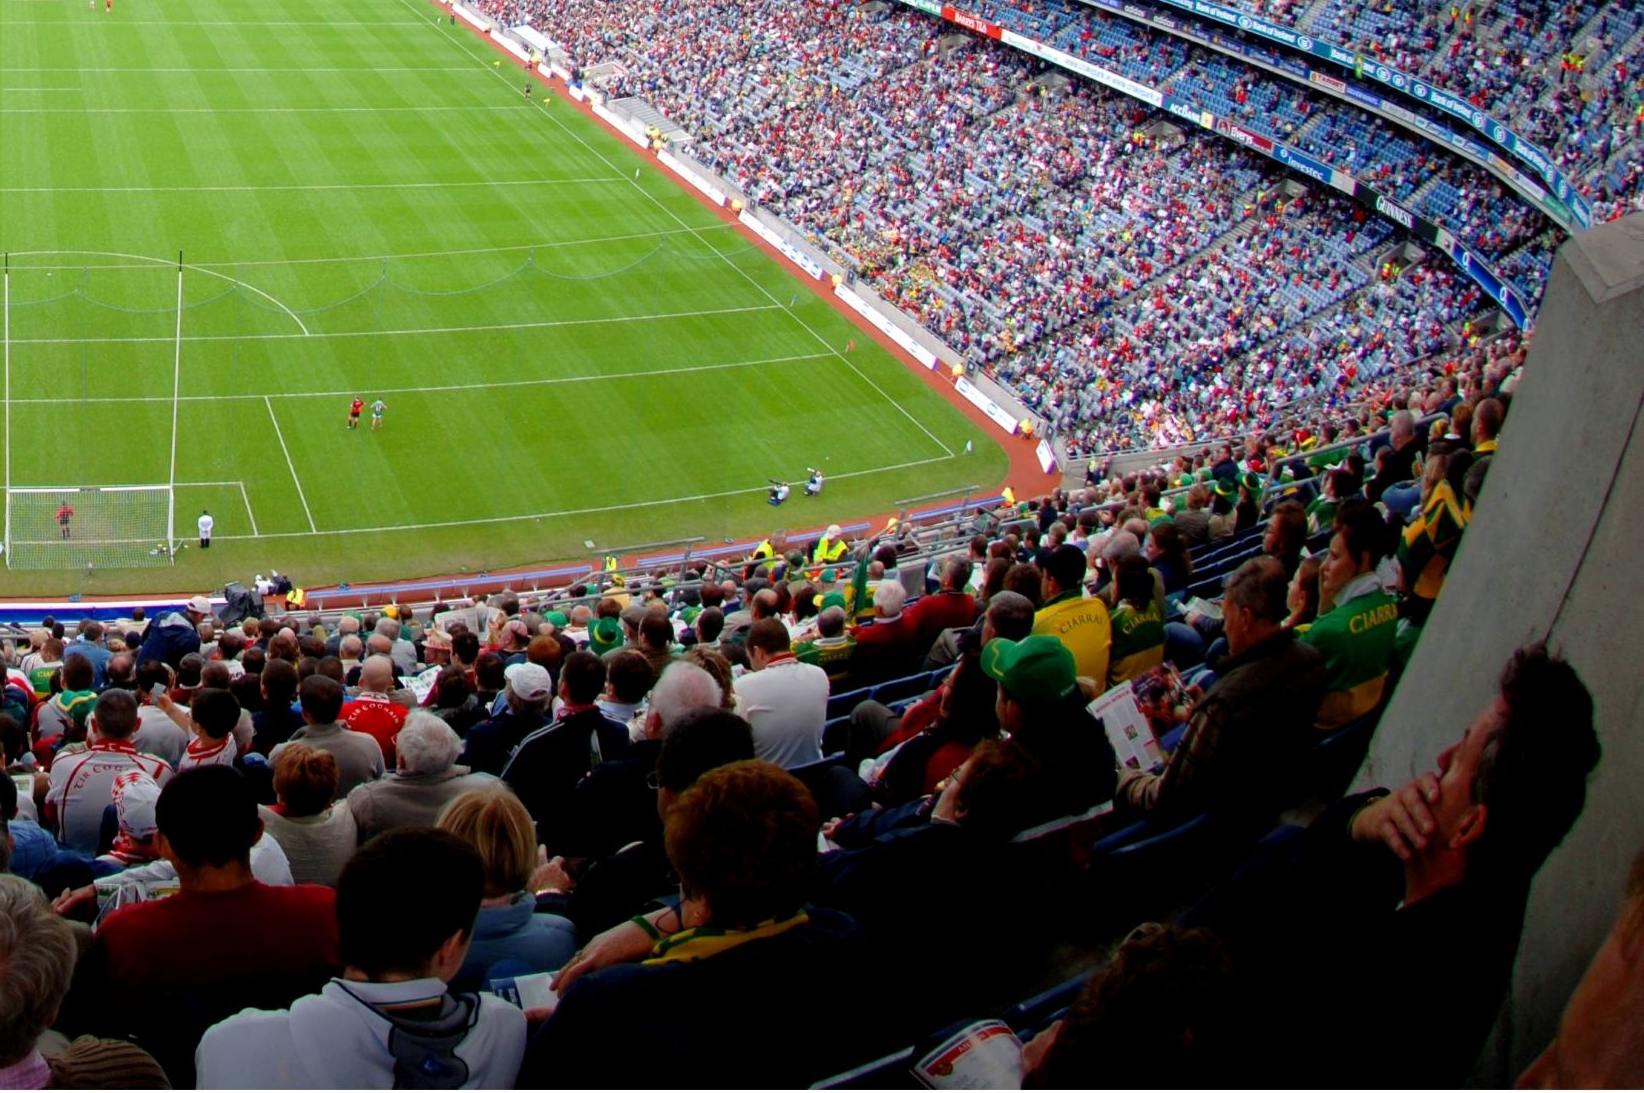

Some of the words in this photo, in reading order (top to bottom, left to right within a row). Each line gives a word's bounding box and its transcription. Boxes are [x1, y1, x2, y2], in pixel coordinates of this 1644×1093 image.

[1153, 13, 1176, 28] adidas
[1195, 1, 1210, 14] Bank
[1216, 8, 1237, 23] Ireland
[975, 20, 987, 33] TEA
[1252, 20, 1268, 32] Bank
[1273, 28, 1296, 43] Ireland
[1287, 155, 1324, 181] Investec
[1376, 195, 1413, 228] GUINNESS
